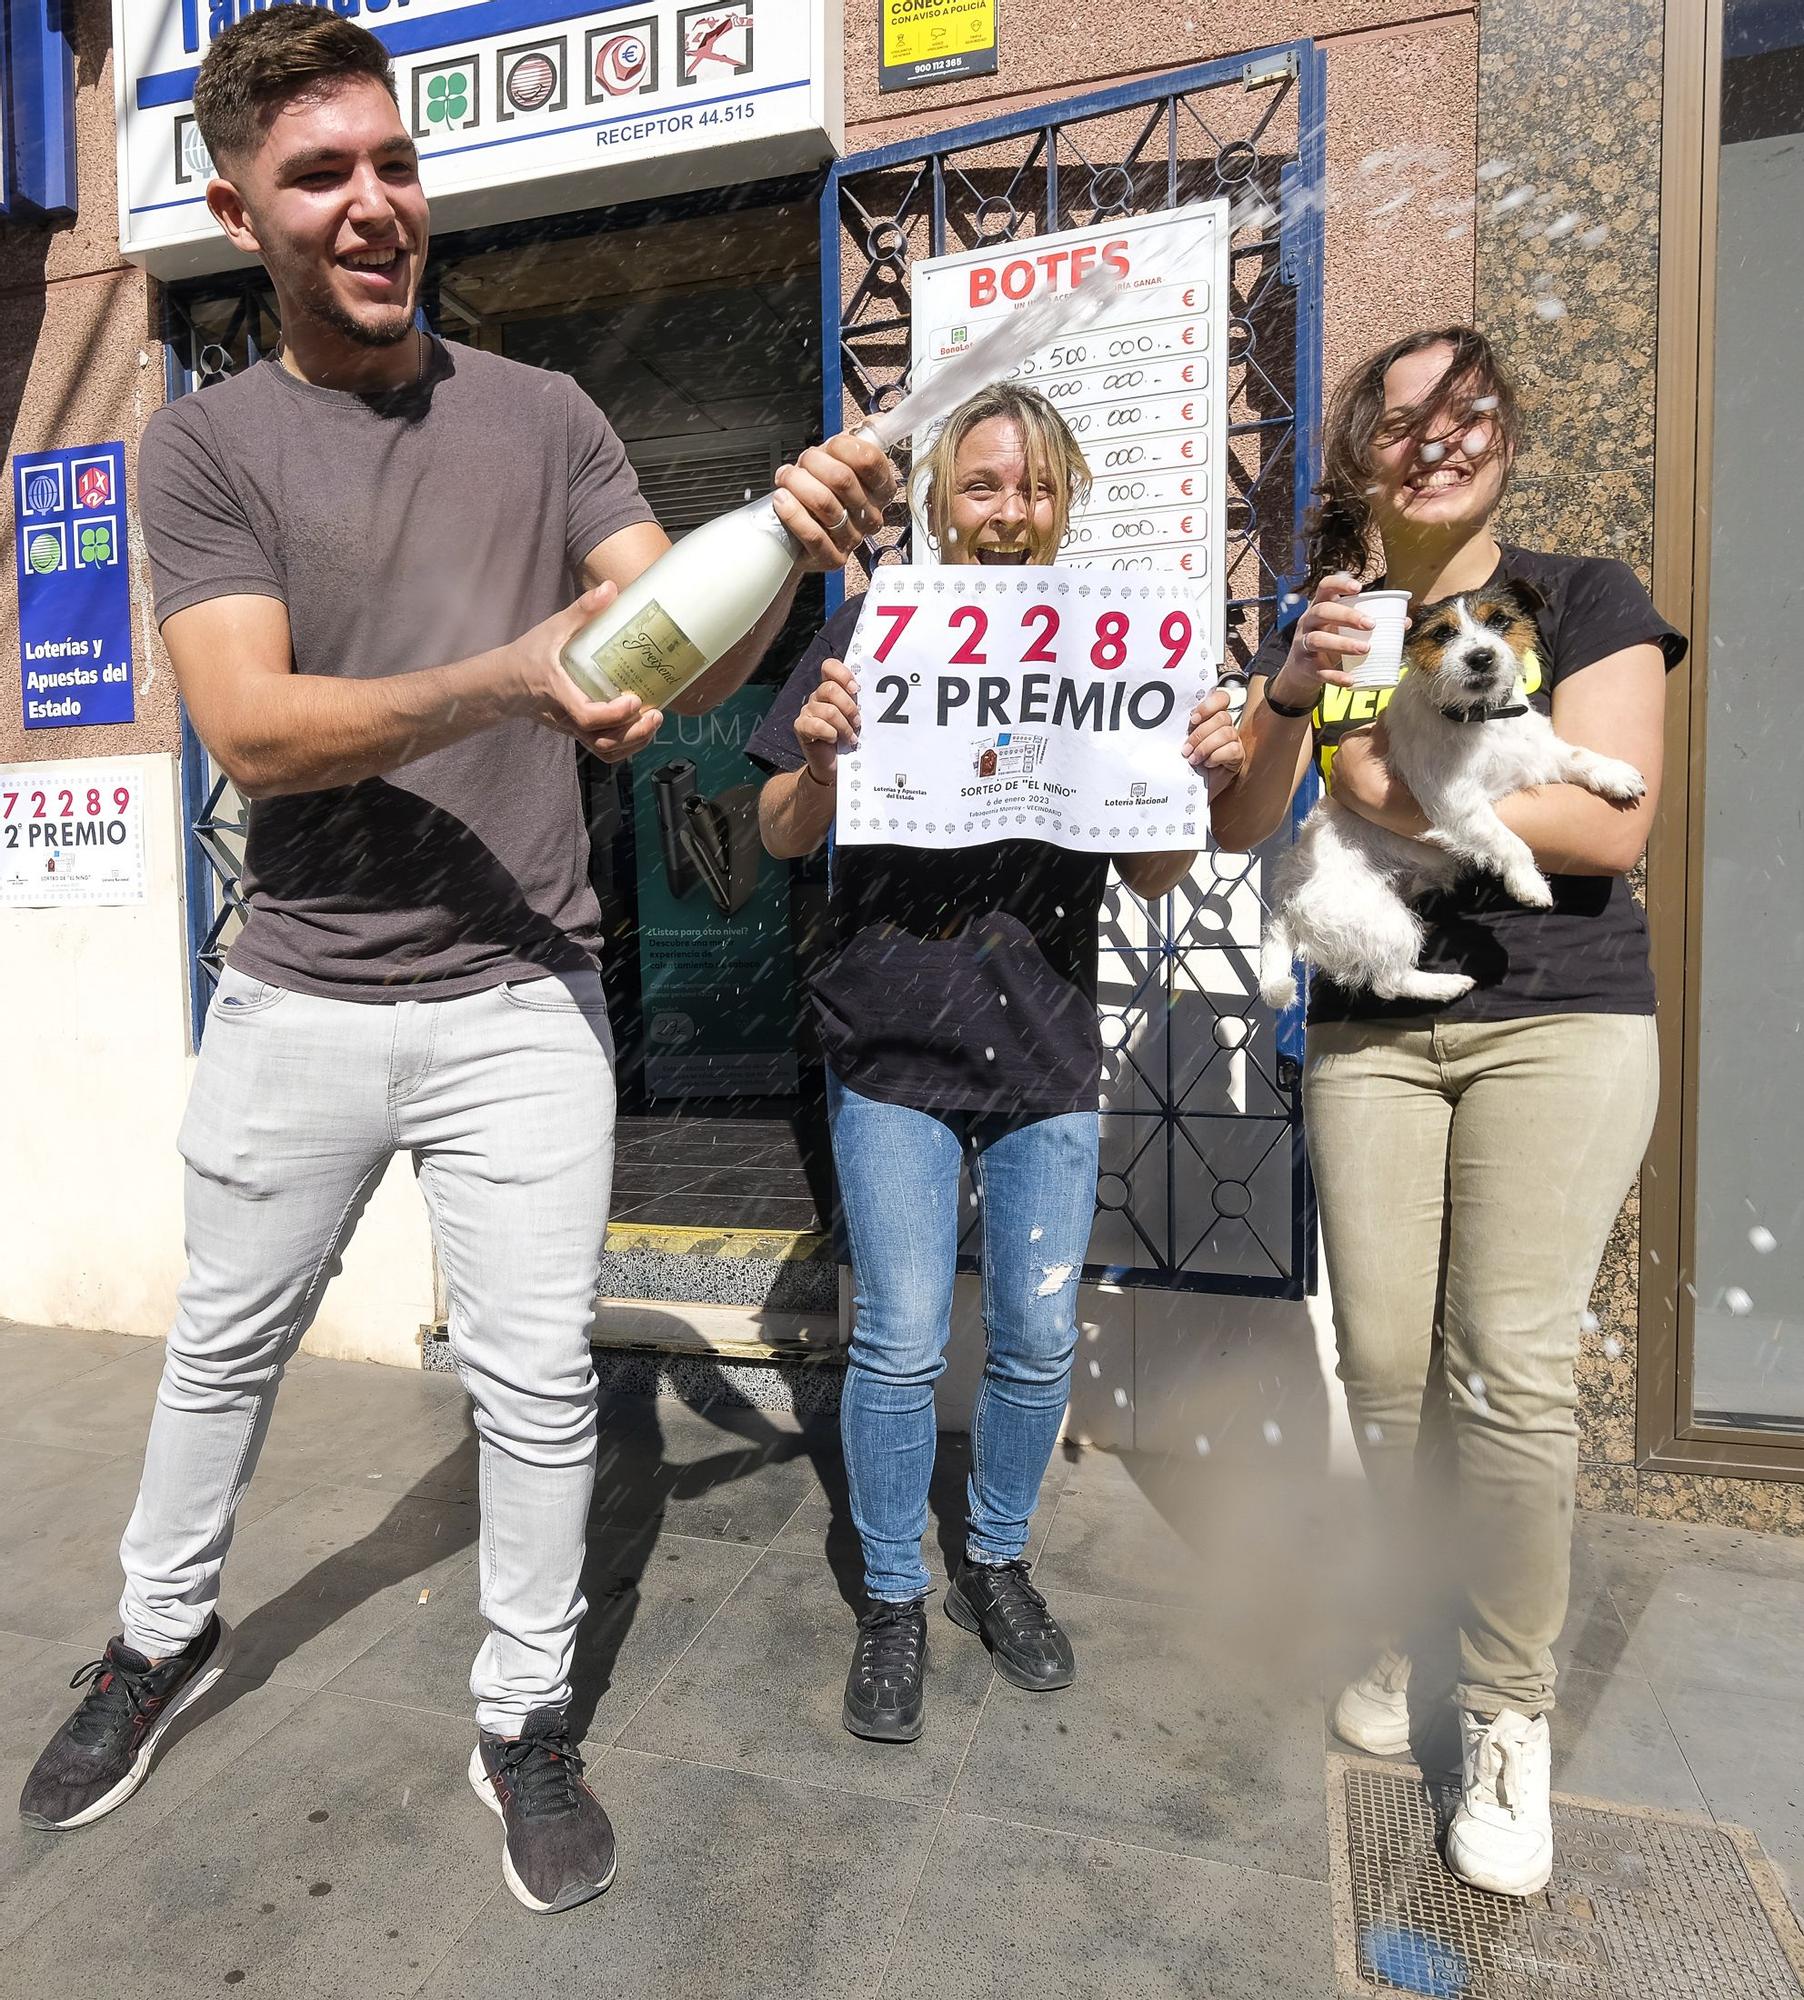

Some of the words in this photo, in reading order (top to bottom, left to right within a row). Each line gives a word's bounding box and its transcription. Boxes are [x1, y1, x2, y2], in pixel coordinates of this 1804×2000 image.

[891, 15, 911, 26] CON
[913, 9, 940, 21] AVISO
[942, 8, 949, 16] A
[914, 63, 931, 74] 900
[932, 60, 944, 70] 112
[946, 57, 962, 68] 365
[596, 115, 694, 147] RECEPTOR
[698, 102, 755, 126] 44.515
[969, 239, 1130, 309] BOTES
[1133, 276, 1162, 288] GANAR
[25, 636, 88, 660] Loterías
[92, 640, 102, 658] y
[26, 667, 98, 693] Apuestas
[102, 662, 128, 683] del
[28, 697, 81, 718] Estado
[936, 673, 1176, 732] PREMIO
[902, 788, 927, 796] Apuestas
[960, 783, 1002, 797] SORTEO
[1005, 780, 1018, 790] DE
[1022, 780, 1040, 790] "EL
[1043, 782, 1076, 797] NIÑO"
[1004, 796, 1026, 804] enero
[1028, 794, 1050, 804] 2023
[1104, 798, 1134, 806] Lotería
[1136, 796, 1168, 805] Nacional
[1026, 805, 1062, 817] VECINDARIO
[28, 820, 126, 848] PREMIO
[680, 929, 701, 938] para
[702, 928, 721, 936] otro
[723, 927, 748, 936] nivel?
